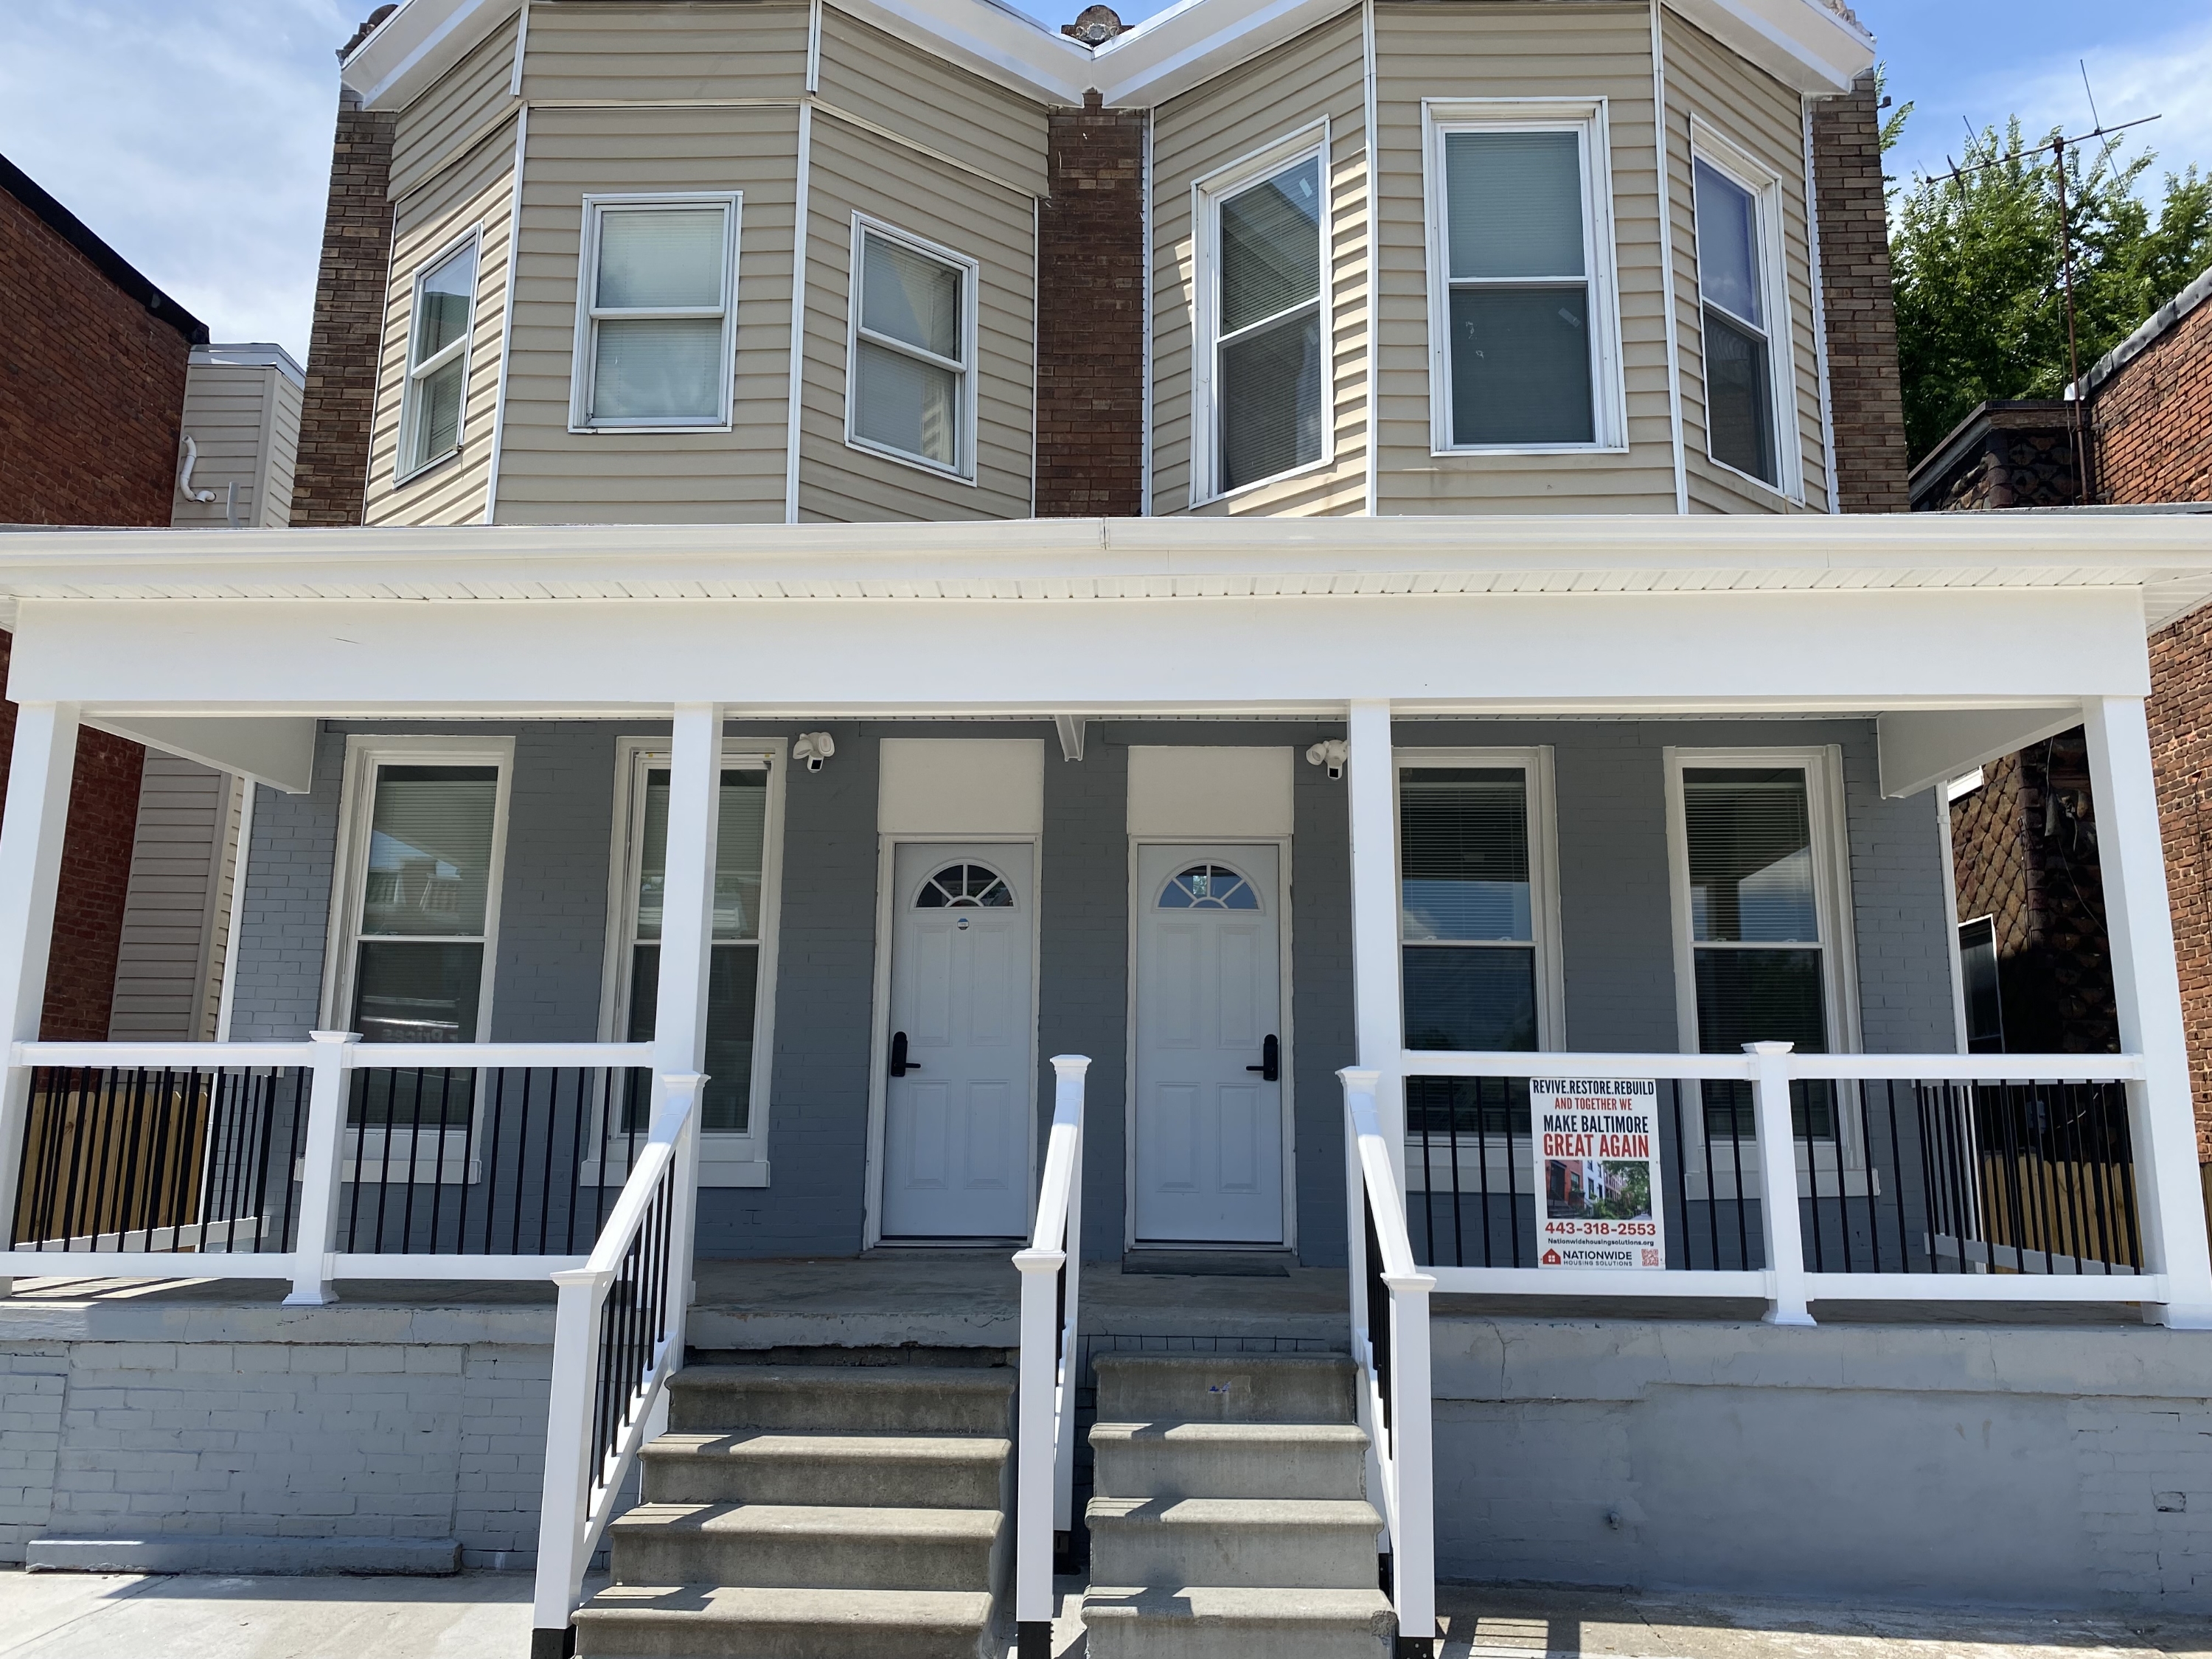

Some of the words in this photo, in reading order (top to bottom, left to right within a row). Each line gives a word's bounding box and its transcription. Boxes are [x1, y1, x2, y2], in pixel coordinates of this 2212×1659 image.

[1555, 1098, 1572, 1110] AND
[1574, 1098, 1617, 1110] TOGETHER
[1620, 1099, 1632, 1110] WE
[1544, 1115, 1577, 1132] MAKE
[1582, 1116, 1649, 1133] BALTIMORE
[1544, 1134, 1593, 1156] GREAT
[1599, 1135, 1649, 1158] AGAIN
[1545, 1222, 1655, 1235] 443-318-2553
[1548, 1238, 1654, 1246] Nationwidehousingsolutions.org
[1563, 1251, 1632, 1259] NATIONWIDE
